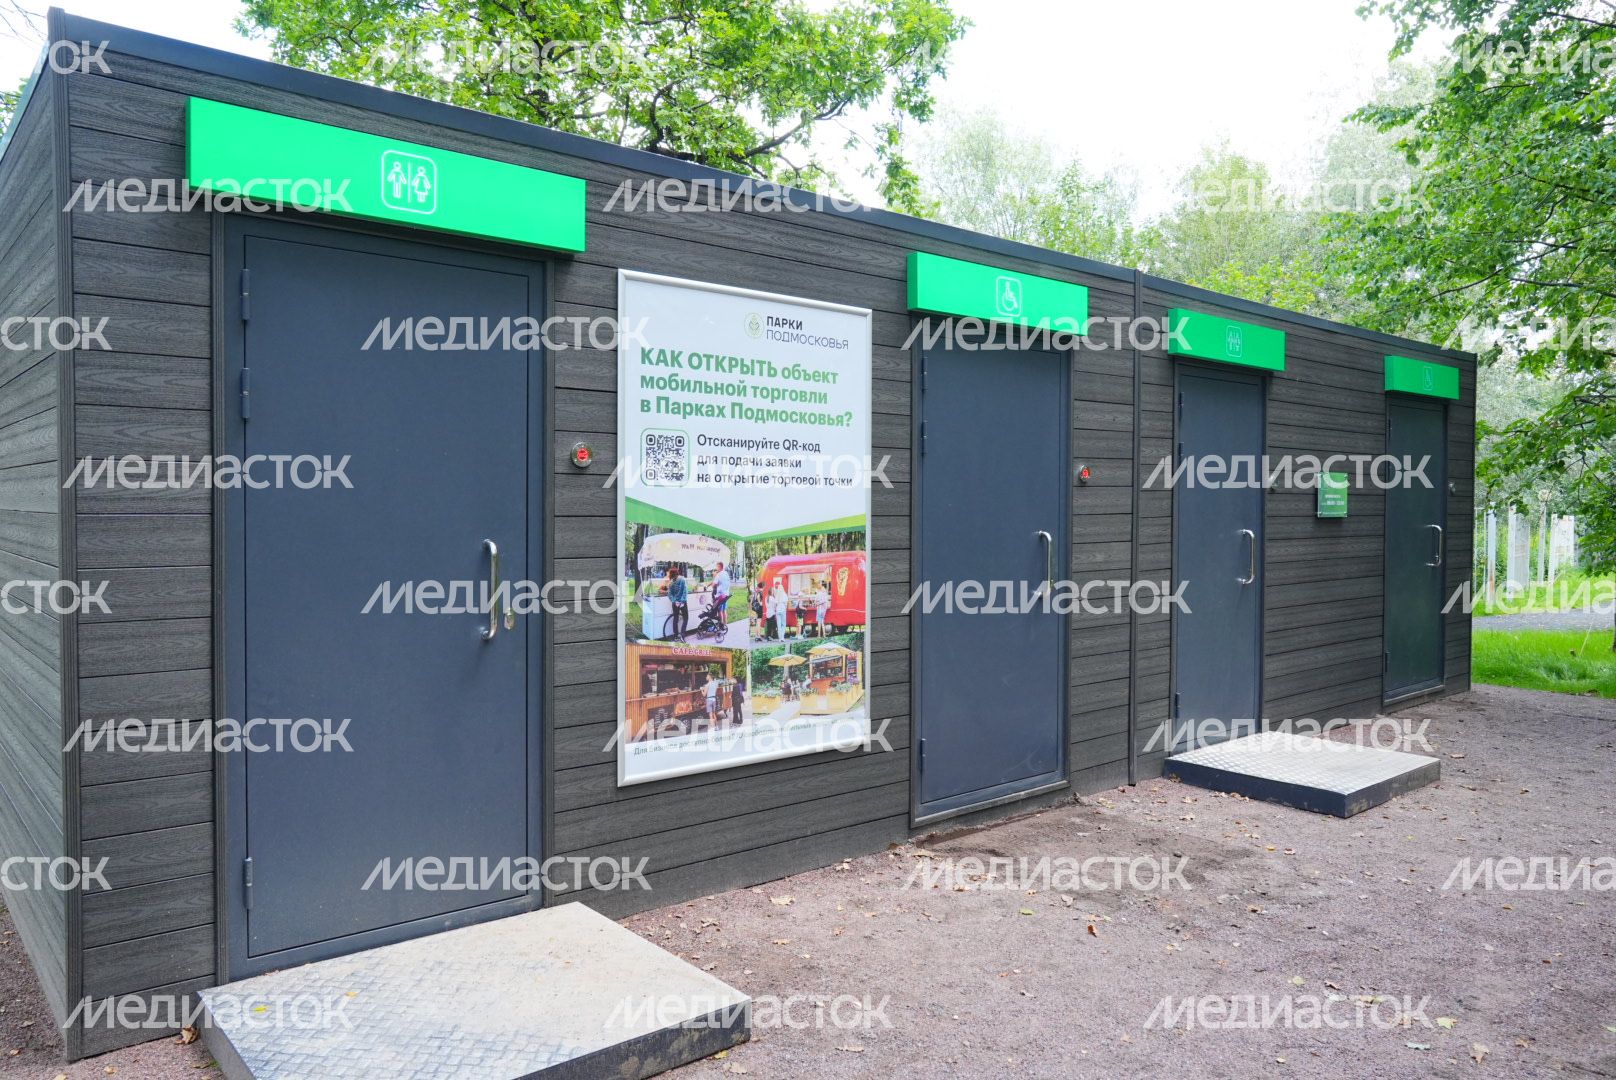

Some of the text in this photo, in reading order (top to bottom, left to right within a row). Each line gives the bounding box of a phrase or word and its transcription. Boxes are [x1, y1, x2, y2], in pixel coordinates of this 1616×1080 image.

[766, 315, 803, 331] ПАРКИ
[766, 329, 849, 350] ПОДМОСКОВЬЯ
[640, 347, 839, 384] КАК ОТКРЫТЬ объект
[640, 374, 828, 404] мобильной торговли
[640, 396, 853, 428] в Парках Подмосковья?
[696, 433, 821, 454] Отсканируйте QR-код
[696, 455, 802, 468] для подачи заявки
[697, 473, 853, 487] на открытие торговой точки
[633, 746, 648, 756] Для
